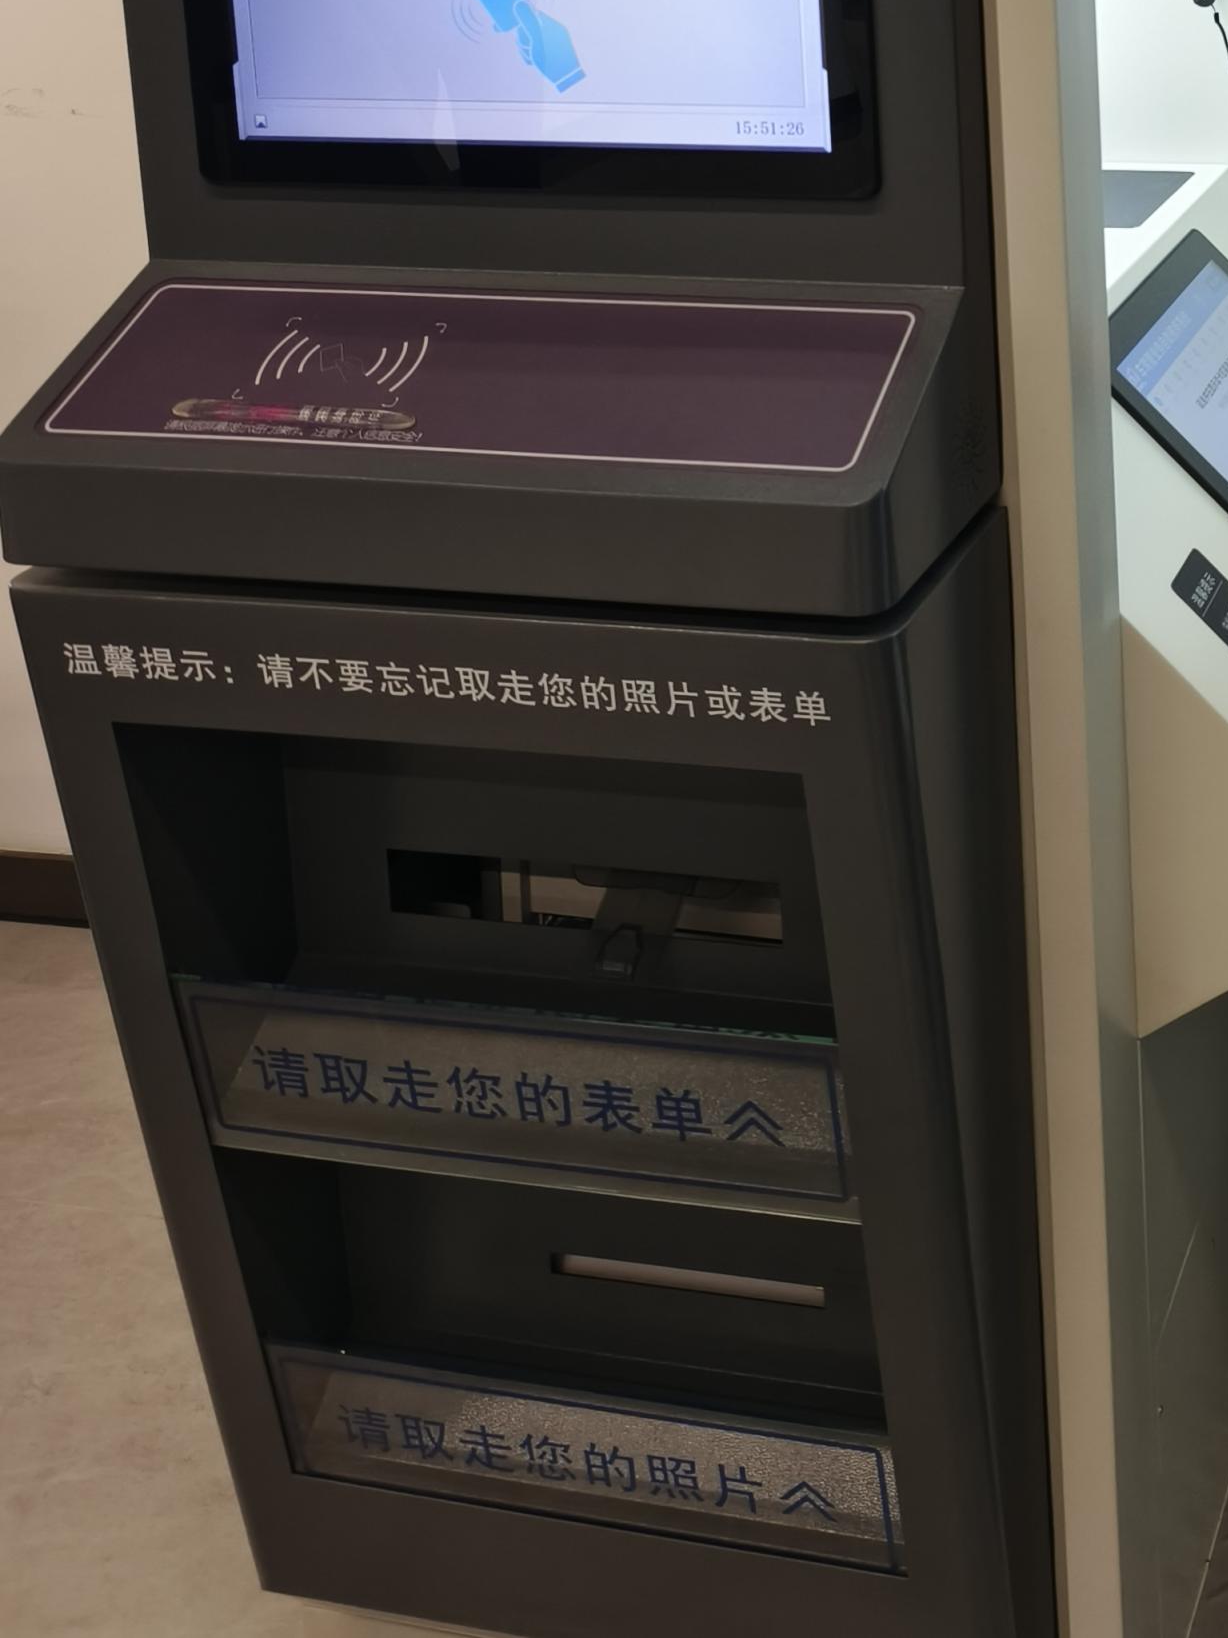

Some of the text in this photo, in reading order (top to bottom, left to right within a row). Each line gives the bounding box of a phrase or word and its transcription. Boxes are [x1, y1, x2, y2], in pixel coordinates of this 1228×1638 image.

[734, 119, 805, 138] 15:51:26
[62, 640, 832, 728] 温馨提示：请不要忘记取走您的照片或表单
[252, 1045, 713, 1143] 请取走您的表单
[338, 1404, 764, 1515] 请取走您的照片
